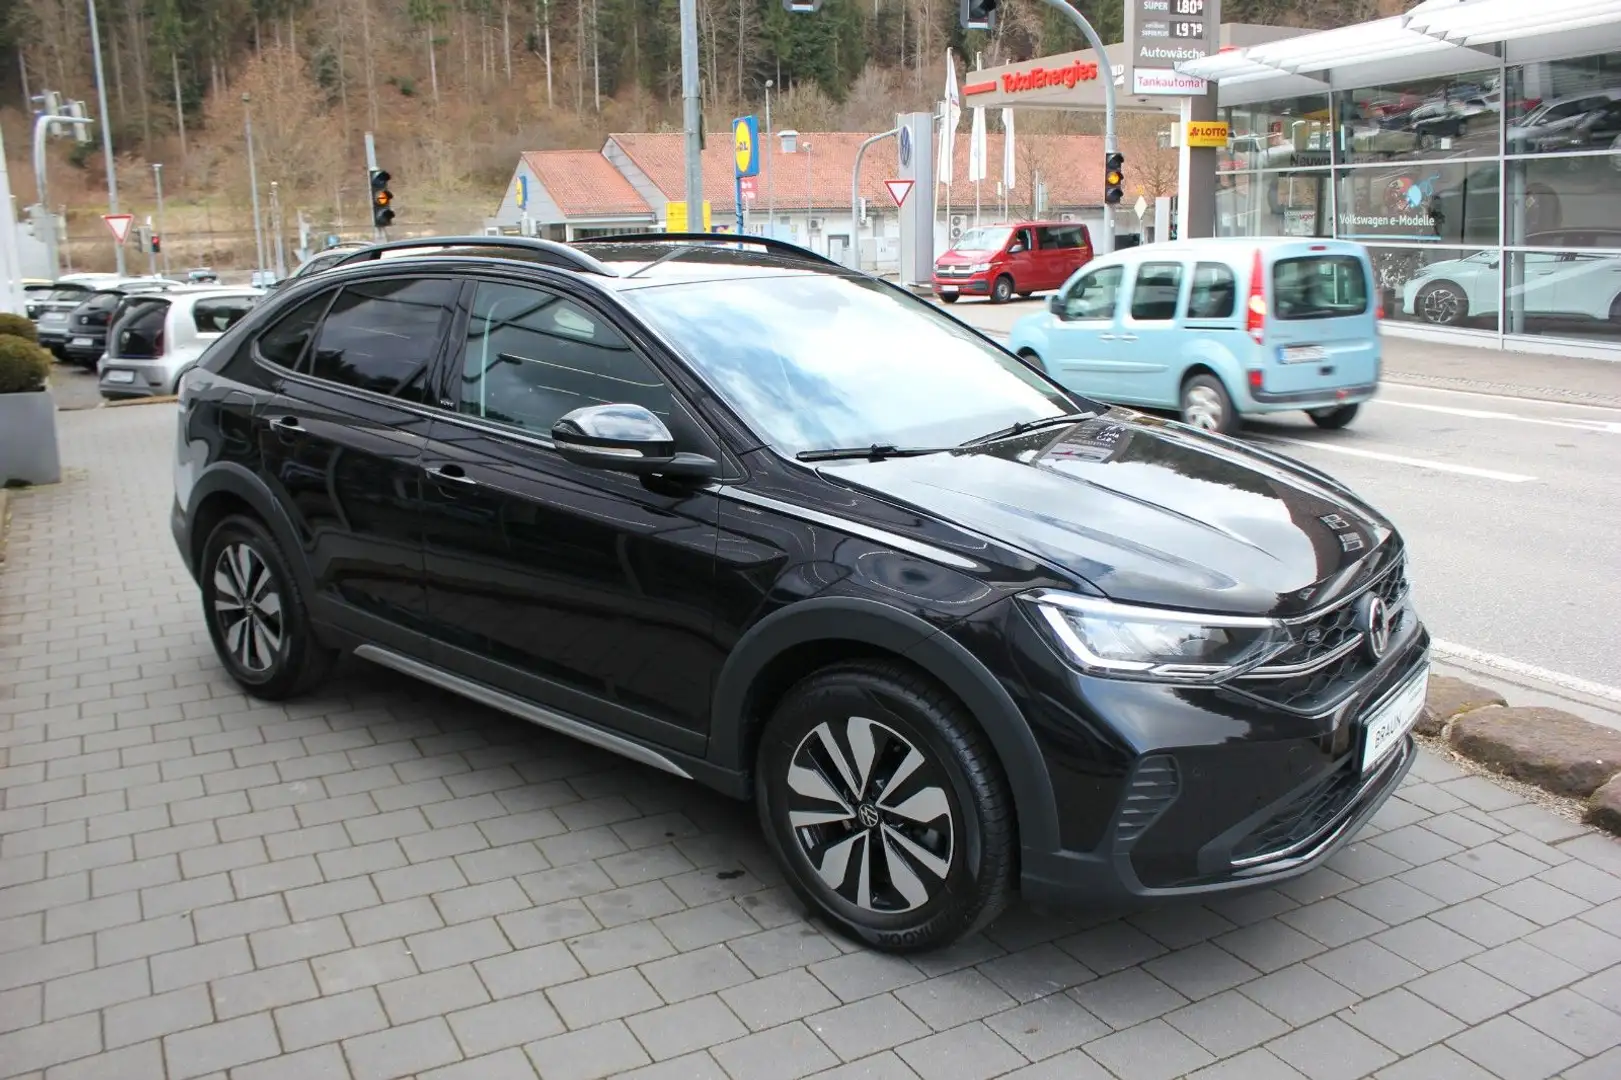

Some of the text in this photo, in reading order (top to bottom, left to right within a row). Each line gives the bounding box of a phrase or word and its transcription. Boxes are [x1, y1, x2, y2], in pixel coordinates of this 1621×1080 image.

[1144, 1, 1168, 11] SUPER
[1140, 46, 1205, 60] Autowäsche
[1002, 60, 1097, 93] TotalEnergies
[1138, 77, 1204, 89] Tankautomat
[1201, 127, 1227, 137] LOTTO
[1340, 213, 1435, 227] Volkswagen e-Modelle
